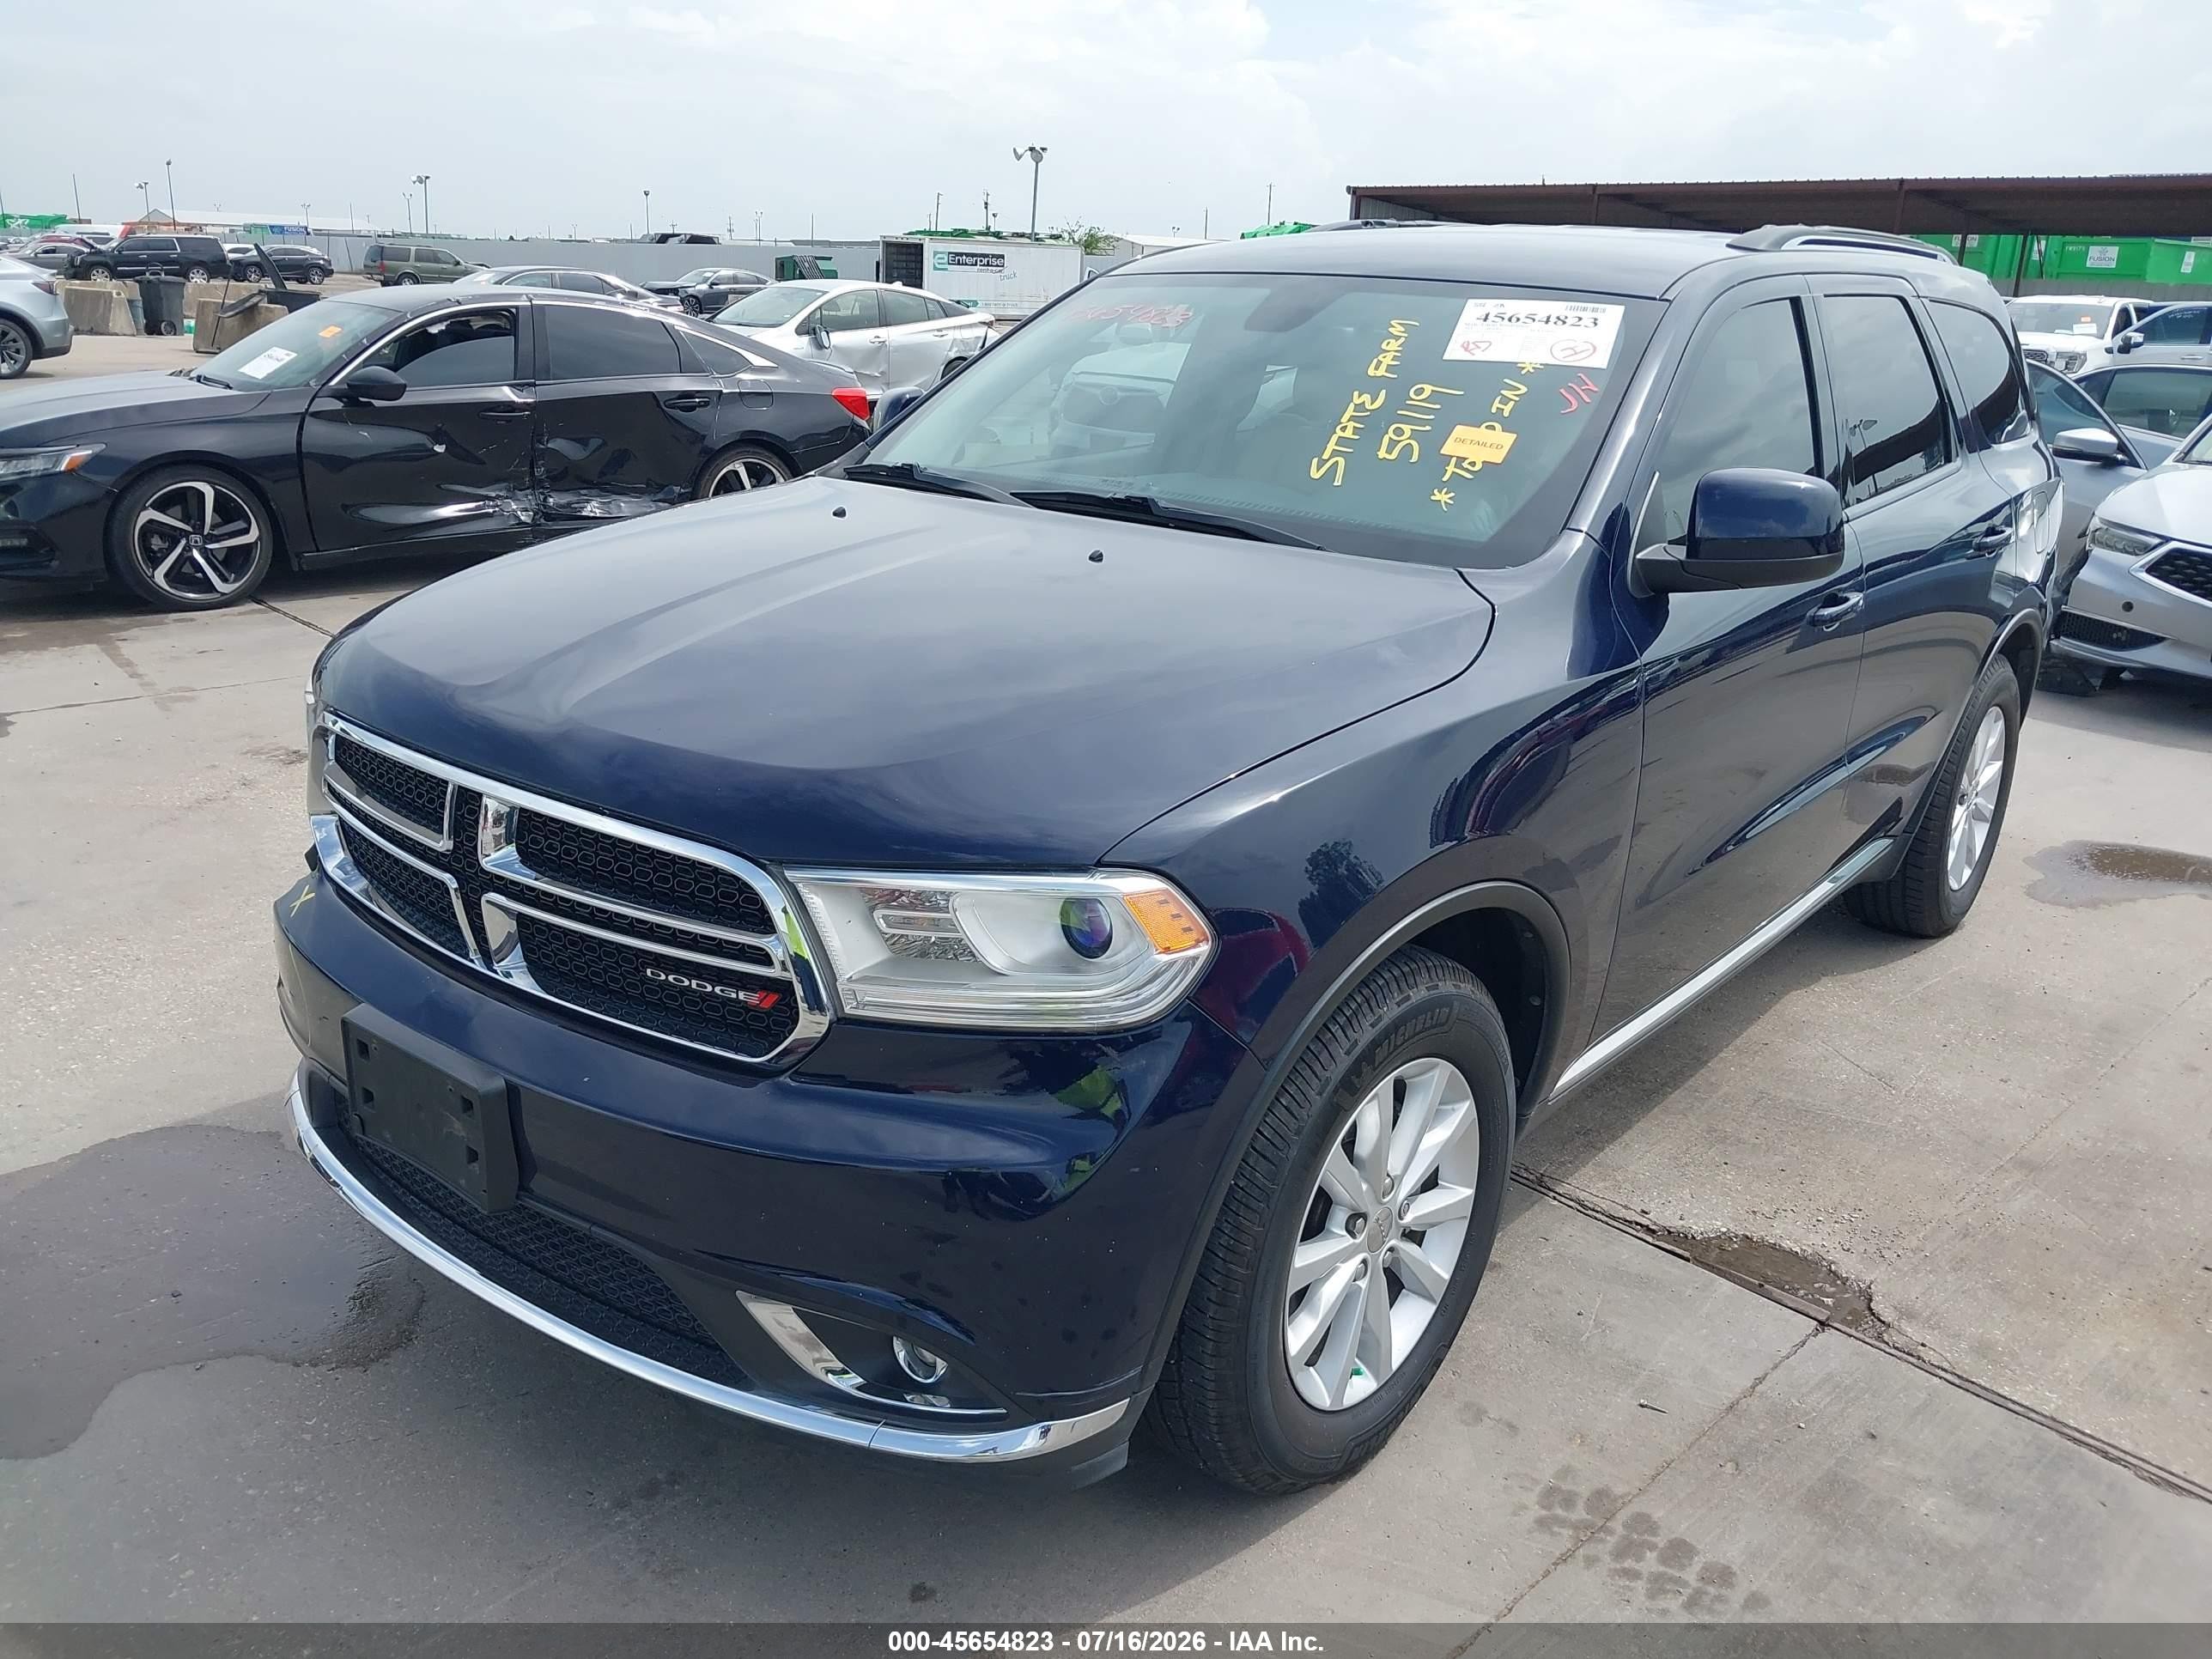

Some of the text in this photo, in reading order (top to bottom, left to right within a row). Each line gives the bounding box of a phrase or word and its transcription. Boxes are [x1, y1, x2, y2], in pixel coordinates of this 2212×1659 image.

[948, 253, 1005, 268] Enterprise
[1000, 270, 1017, 282] truck
[1476, 311, 1599, 329] 45654823
[1310, 319, 1419, 486] STATE FARM
[1491, 378, 1528, 417] IN
[1376, 384, 1464, 463] 59119
[1454, 436, 1504, 451] DETAILED
[646, 968, 760, 1004] DODGE
